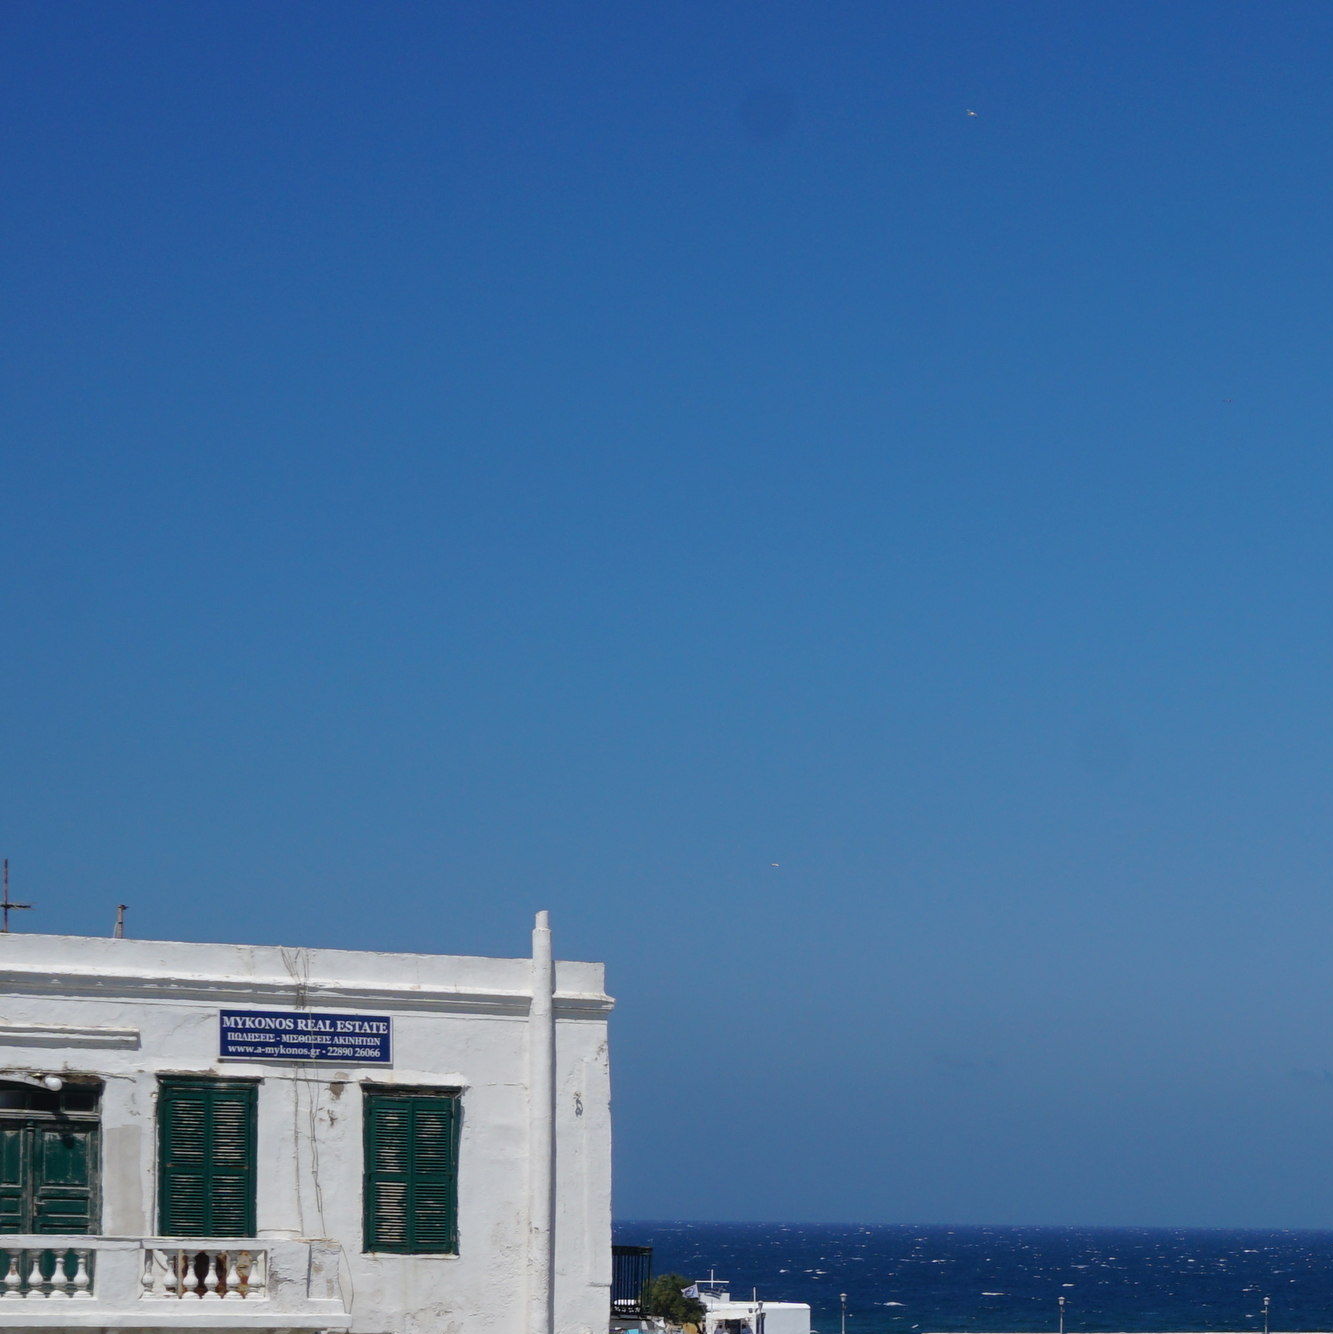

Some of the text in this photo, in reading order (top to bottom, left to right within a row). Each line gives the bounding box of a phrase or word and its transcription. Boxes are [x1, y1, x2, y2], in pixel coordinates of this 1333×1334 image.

[222, 1016, 388, 1034] MYKONOS REAL ESTATE
[227, 1032, 276, 1042] ΠΩΛΗΣΕΙΣ
[333, 1036, 381, 1046] ΑΚΙΝΗΤΩΝ
[228, 1044, 381, 1058] www.a-mykonos.gr 22890 26066
